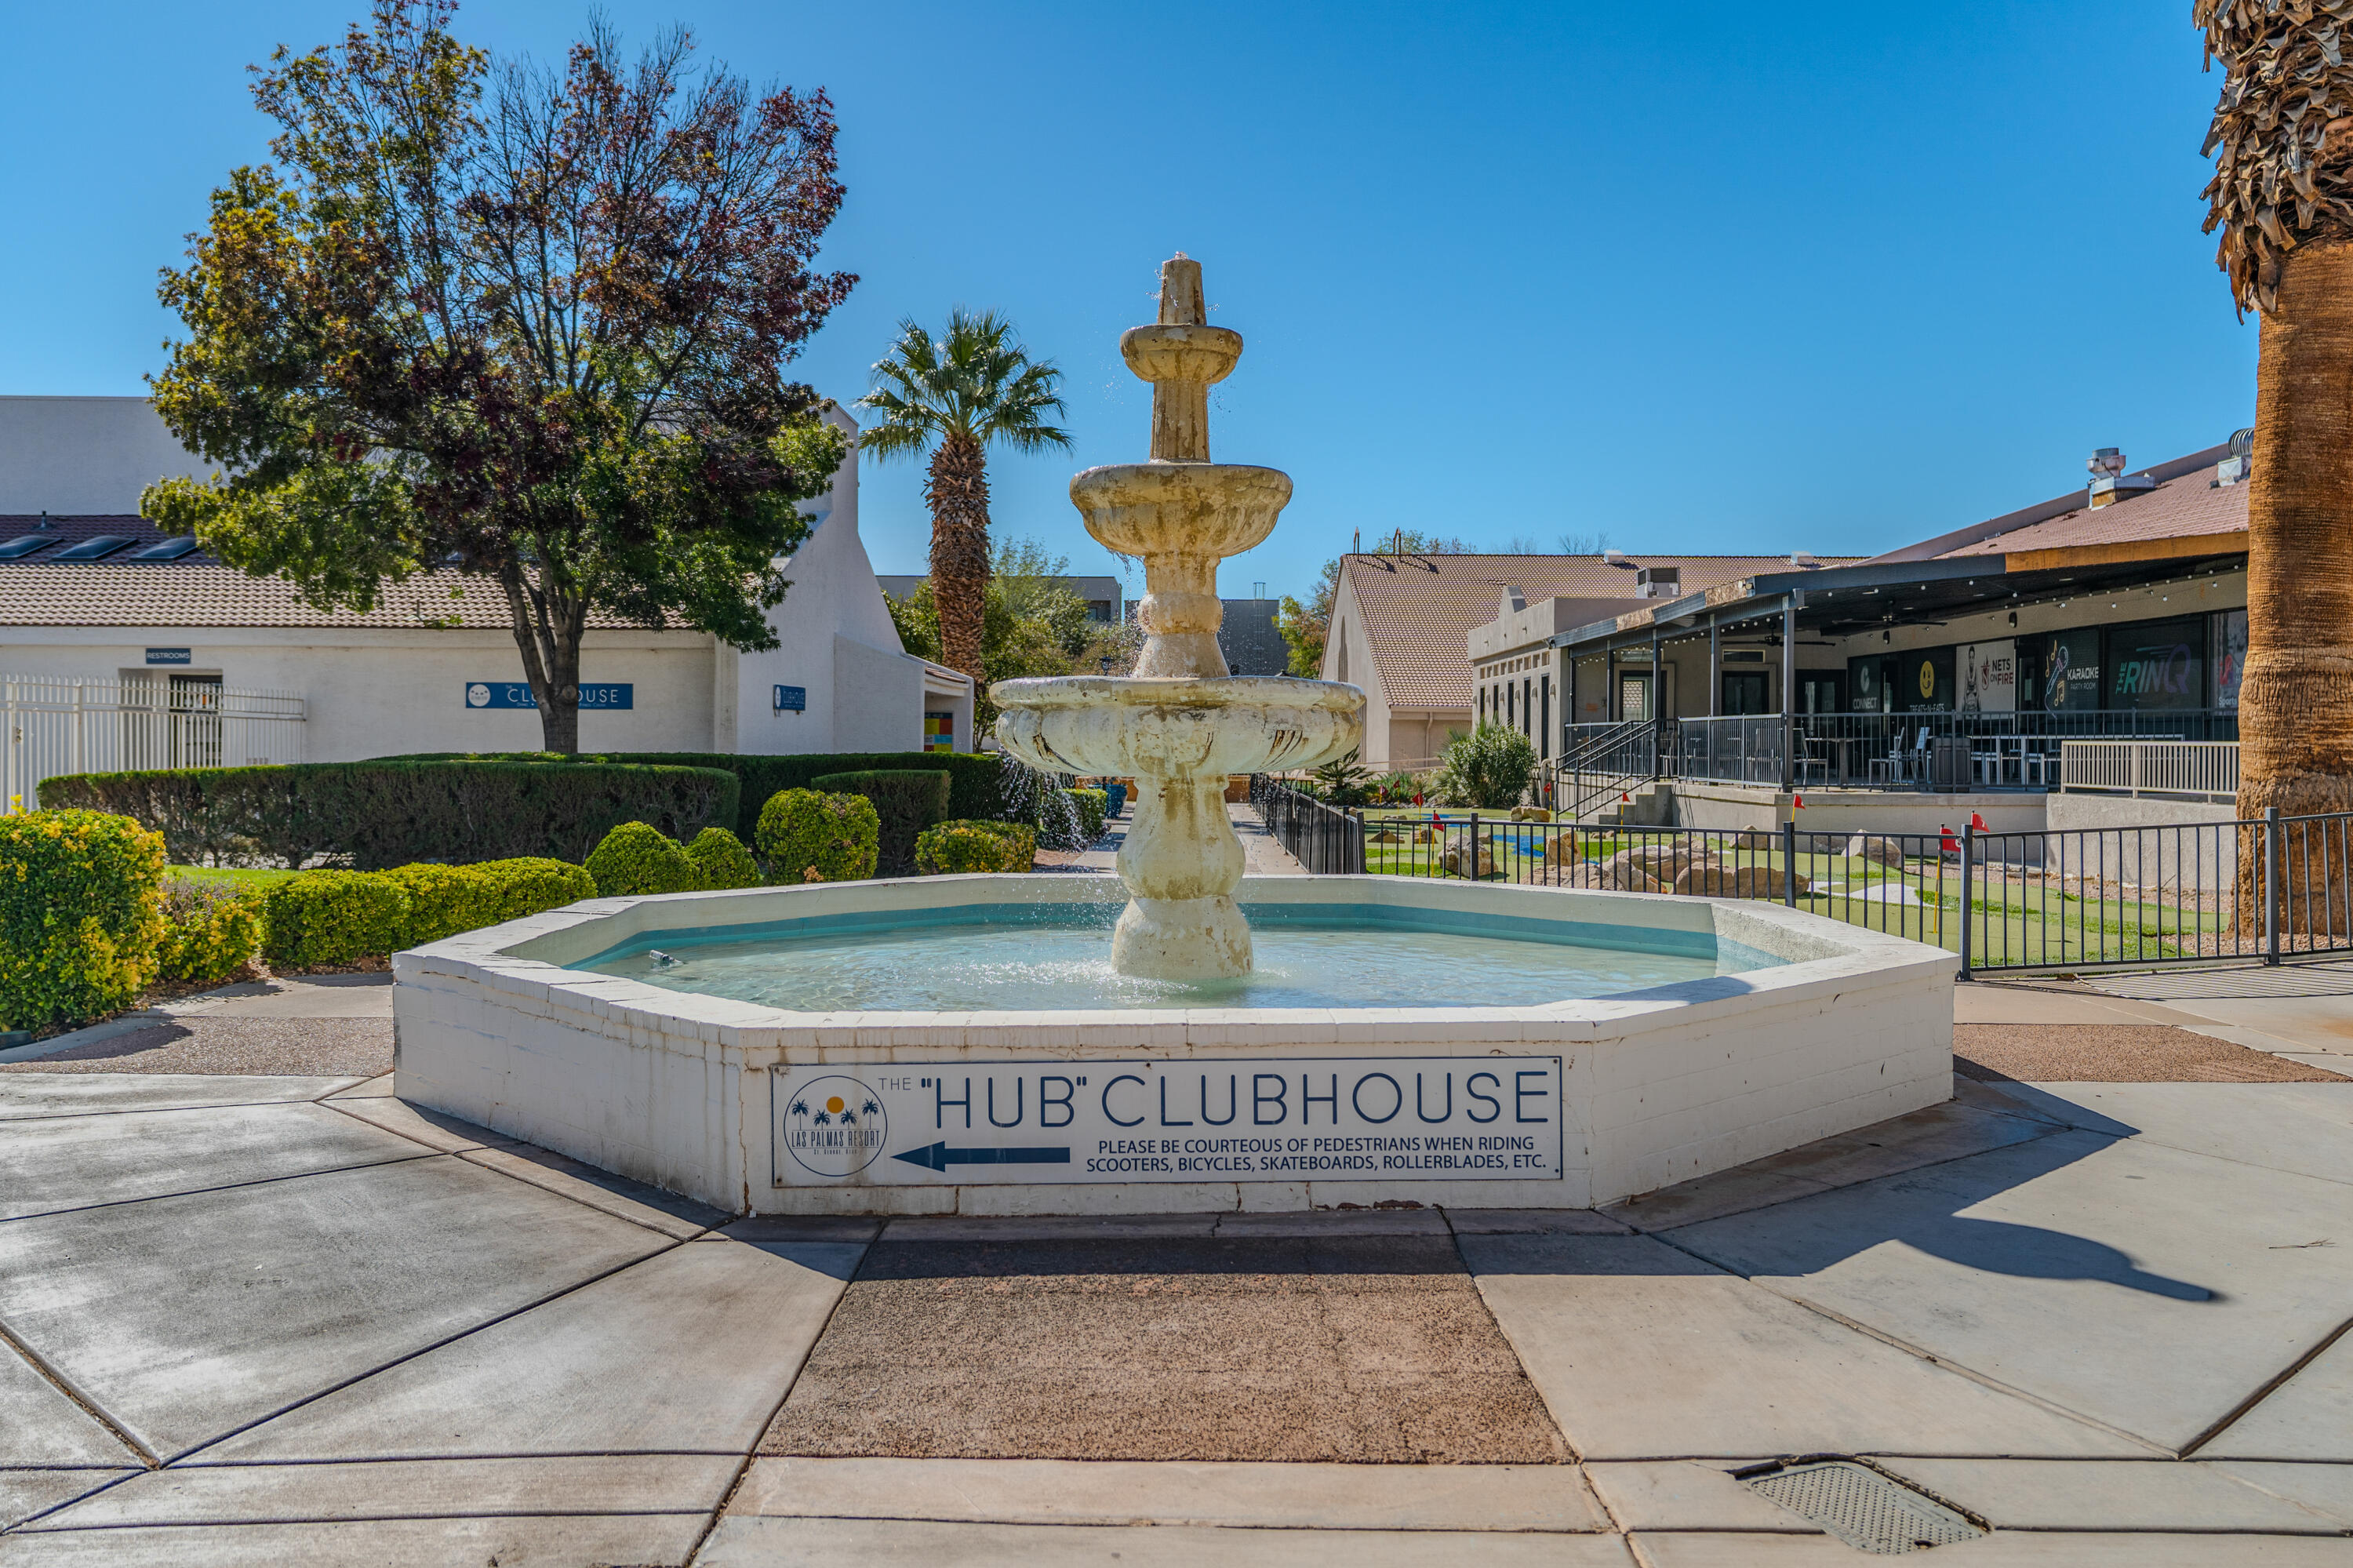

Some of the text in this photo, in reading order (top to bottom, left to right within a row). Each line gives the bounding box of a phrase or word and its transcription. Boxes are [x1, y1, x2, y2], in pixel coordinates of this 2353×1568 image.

[1992, 658, 2011, 671] NETS
[1990, 672, 2013, 685] ON FIRE
[2067, 666, 2099, 681] KARAOKE
[1853, 697, 1878, 710] CONNECT
[2219, 696, 2238, 708] Sports
[878, 1078, 911, 1090] THE
[1101, 1071, 1548, 1127] CLUBHOUSE
[791, 1130, 880, 1148] LAS PALMAS RESORT
[1098, 1136, 1534, 1155] PLEASE BE COURTEOUS OF PEDESTRIANS WHEN RIDING
[1086, 1154, 1547, 1173] SCOOTERS, BICYCLES, SKATEBOARDS, ROLLERBLADES, ETC.
